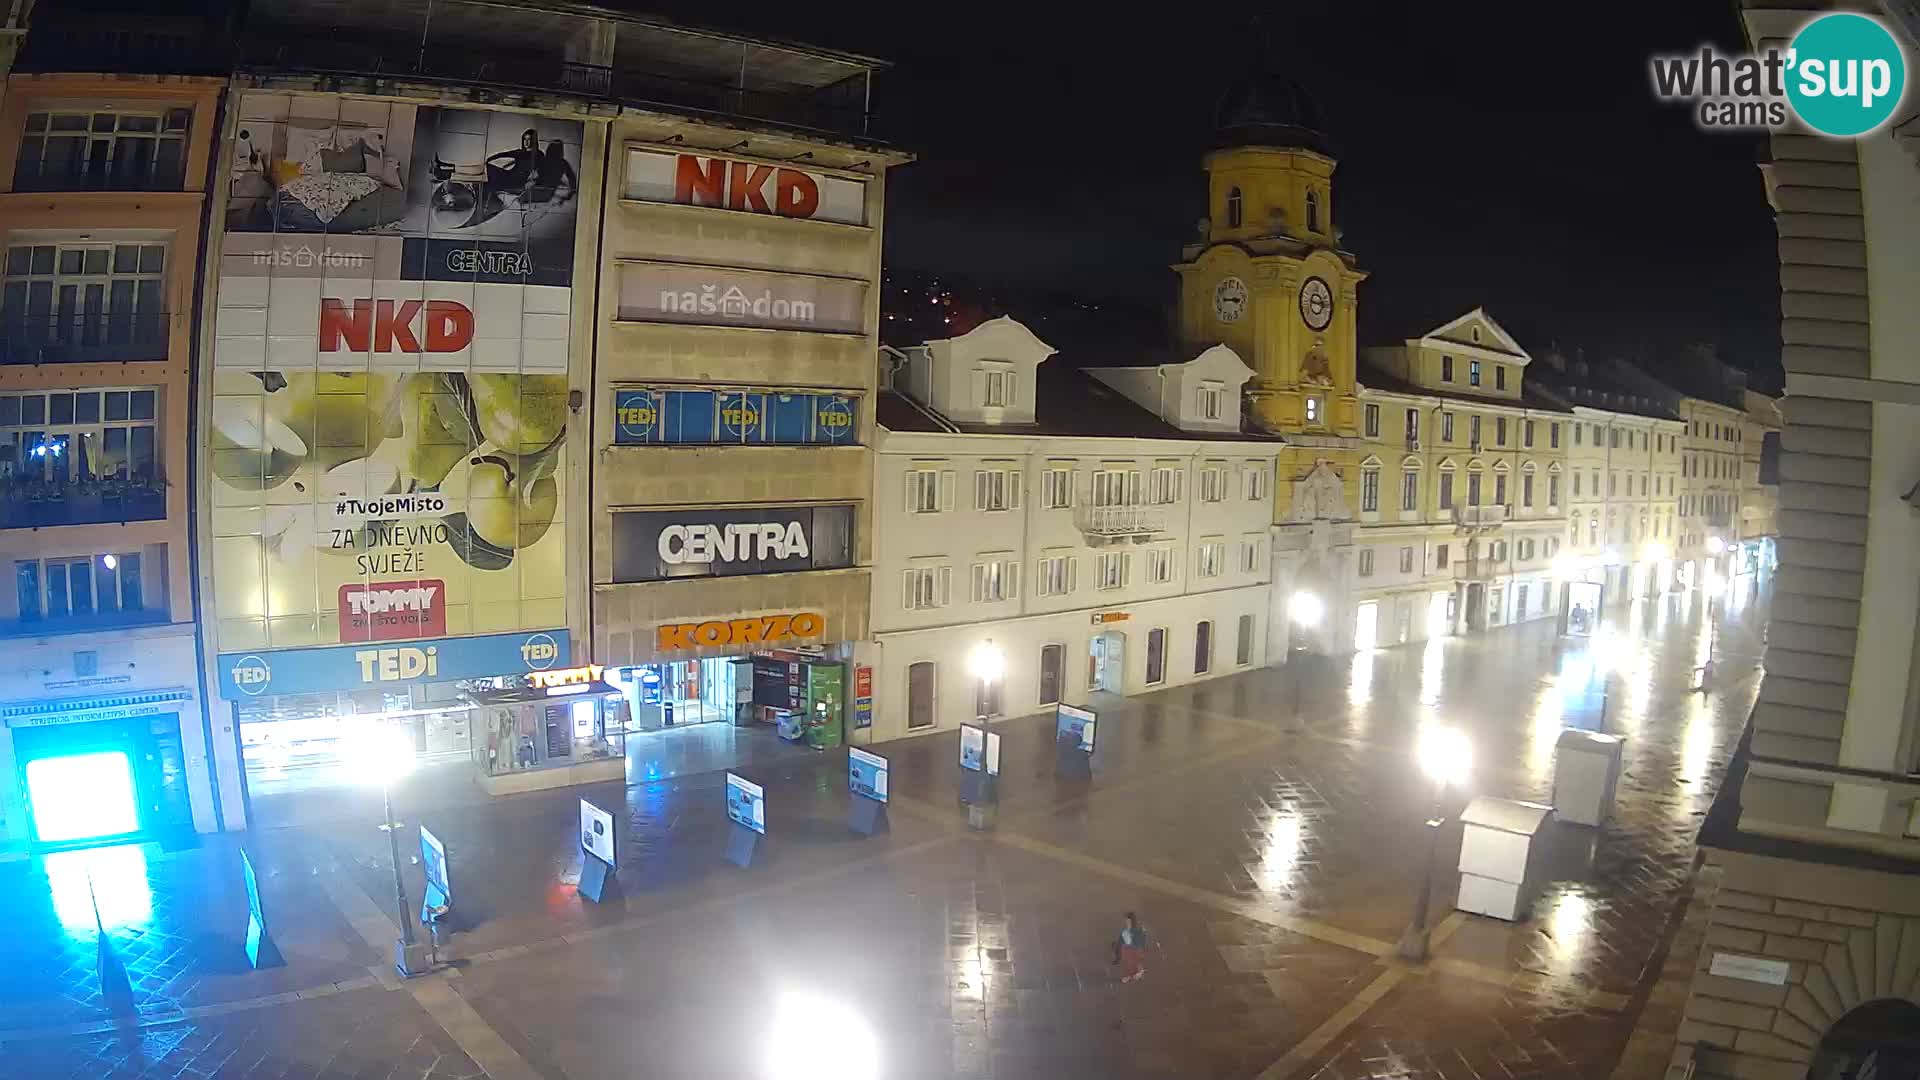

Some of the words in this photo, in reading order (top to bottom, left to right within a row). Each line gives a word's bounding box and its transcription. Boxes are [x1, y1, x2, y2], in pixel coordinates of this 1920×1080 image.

[676, 154, 819, 218] NKD
[447, 249, 534, 275] CENTRA
[660, 284, 717, 316] naš
[753, 290, 815, 320] dom
[319, 297, 475, 353] NKD
[617, 408, 656, 425] TEDi
[722, 409, 759, 426] TEDi
[818, 411, 852, 427] TEDi
[336, 497, 444, 516] #TvojeMisto
[331, 529, 356, 549] ZA
[366, 524, 449, 548] DNEVNO
[658, 521, 809, 564] CENTRA
[357, 547, 425, 575] SVJEŽE
[347, 587, 437, 614] TOMMY
[656, 612, 824, 651] KORZO
[232, 666, 271, 684] TEDi
[356, 647, 438, 682] TEDi
[521, 643, 558, 661] TEDi
[531, 664, 604, 688] TOMMY
